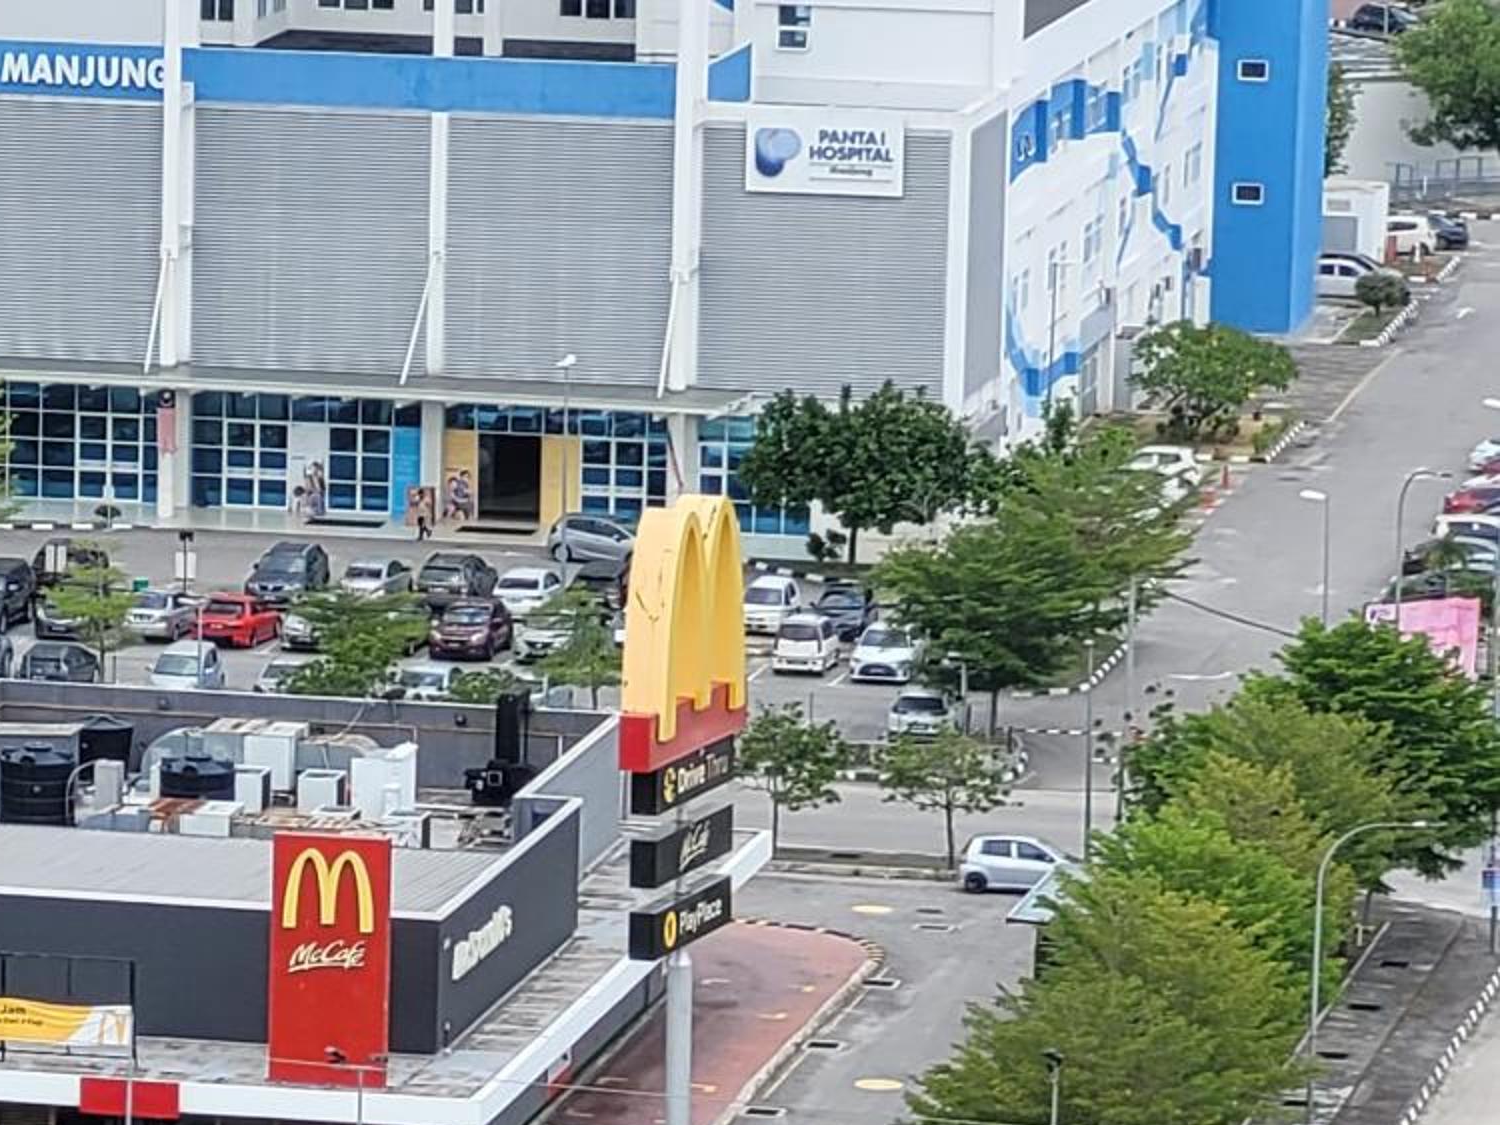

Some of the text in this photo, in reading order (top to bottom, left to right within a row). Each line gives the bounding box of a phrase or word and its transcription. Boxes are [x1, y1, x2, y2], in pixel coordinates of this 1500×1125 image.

[1, 51, 164, 90] MANJUNG
[819, 130, 886, 145] PANTAI
[809, 145, 894, 163] HOSPITAL
[677, 762, 706, 795] Drive
